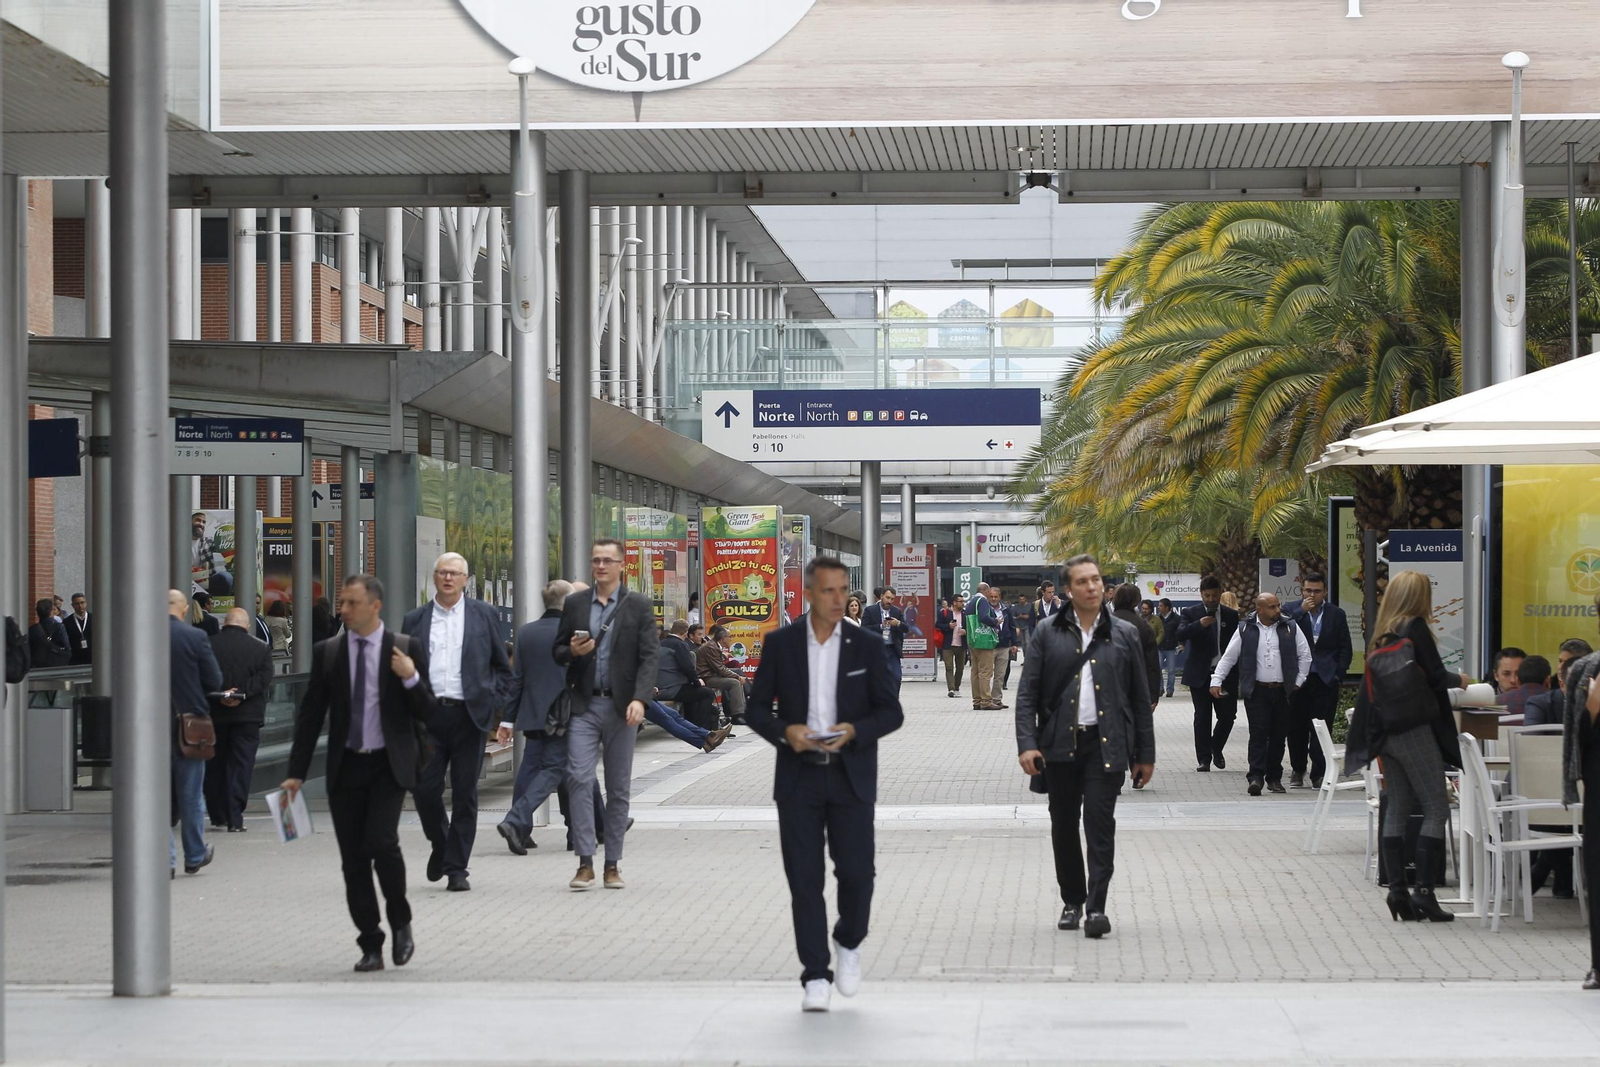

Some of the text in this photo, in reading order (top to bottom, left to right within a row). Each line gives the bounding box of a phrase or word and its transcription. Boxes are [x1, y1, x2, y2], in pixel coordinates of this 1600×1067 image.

[572, 0, 701, 52] gusto
[581, 38, 701, 82] del Sur
[759, 411, 795, 422] Norte
[806, 410, 839, 422] North
[752, 443, 784, 452] 9 10
[989, 533, 1010, 542] fruit
[989, 543, 1043, 552] attraction
[1400, 543, 1457, 552] La Avenida
